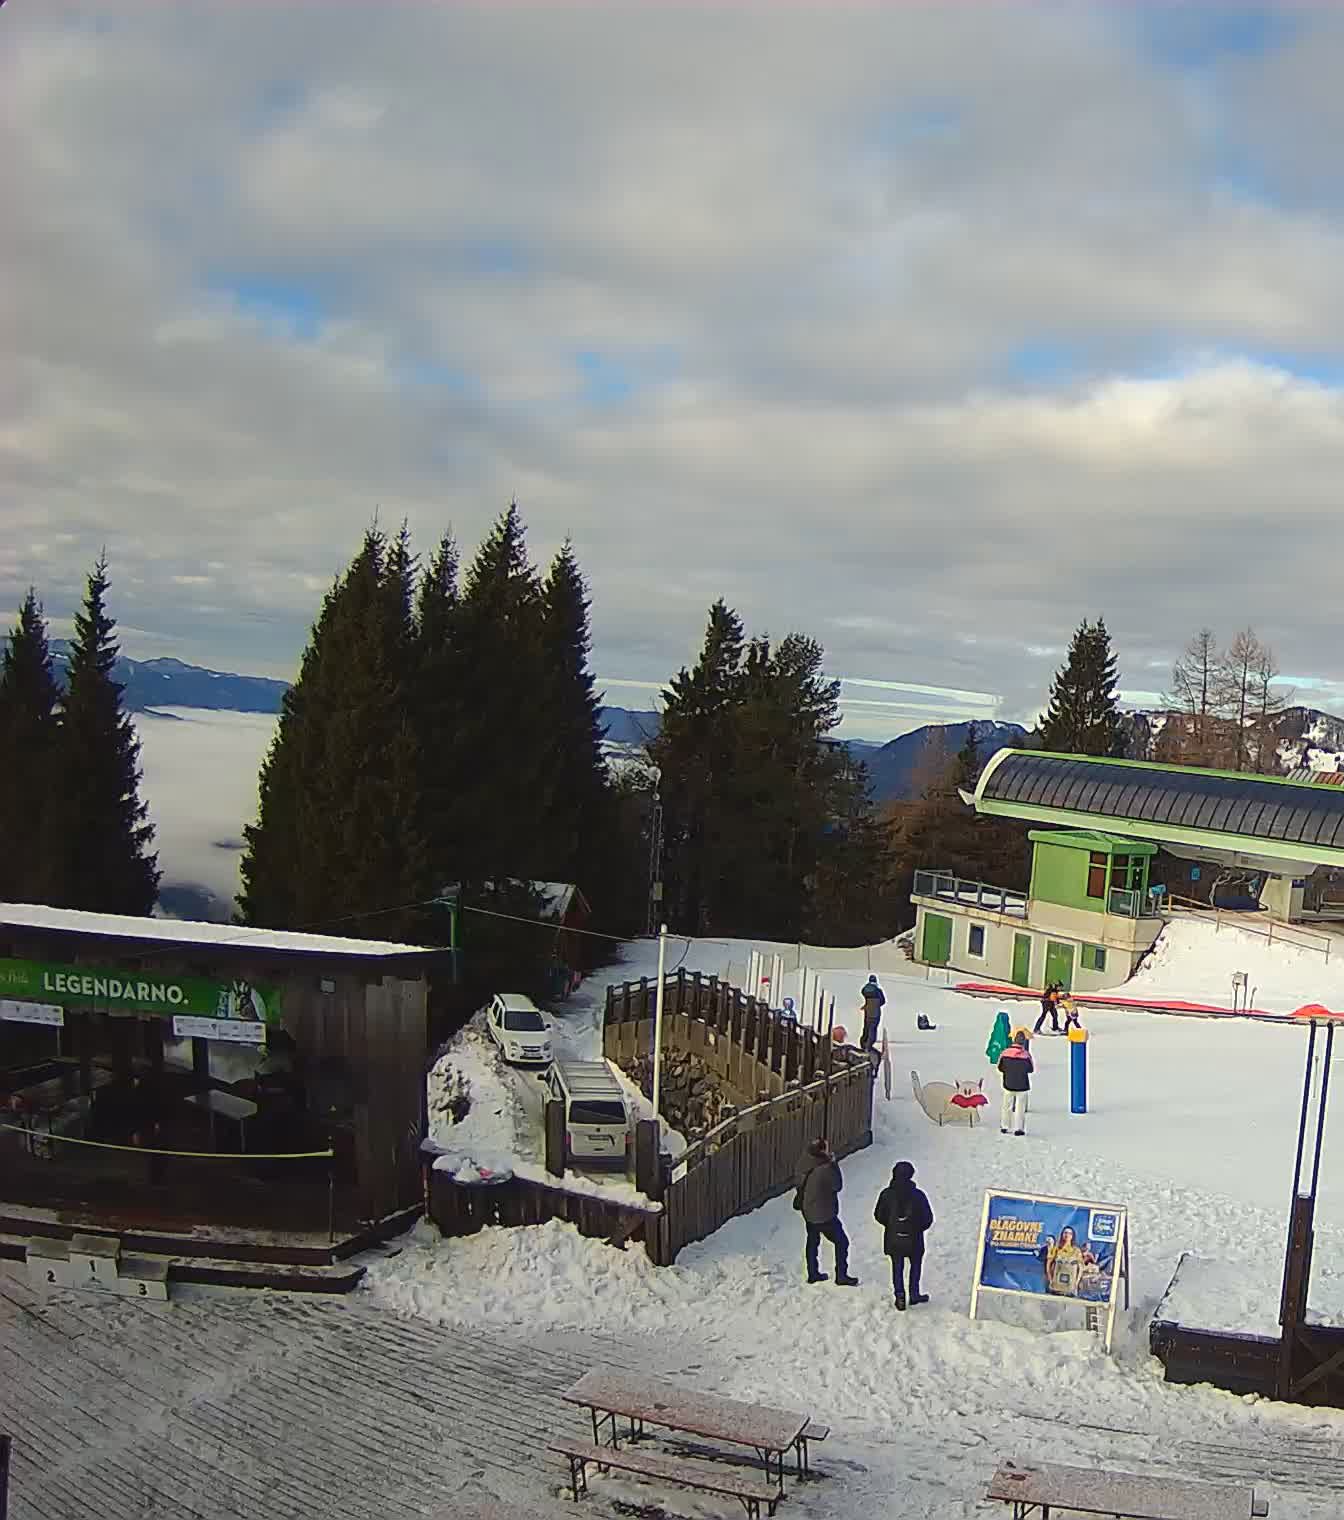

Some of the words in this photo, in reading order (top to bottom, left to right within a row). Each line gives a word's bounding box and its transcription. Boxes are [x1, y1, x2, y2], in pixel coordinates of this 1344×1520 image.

[43, 972, 190, 1005] LEGENDARNO.
[47, 1269, 56, 1283] 2
[138, 1283, 148, 1296] 3
